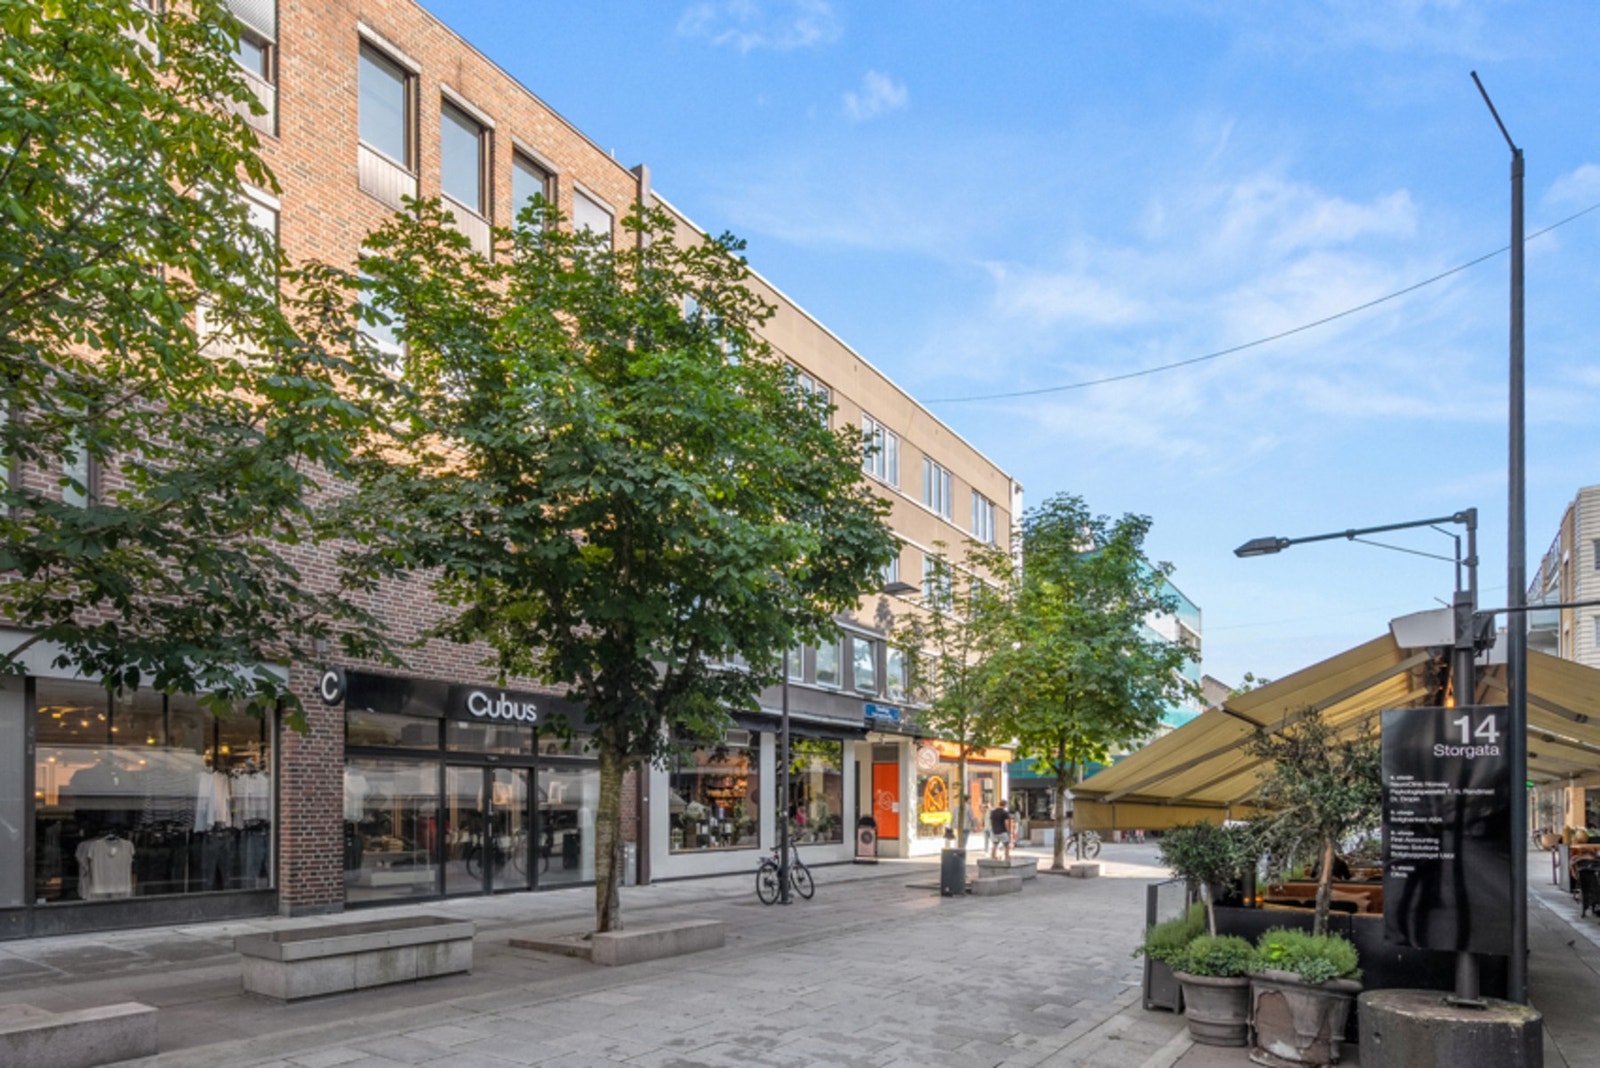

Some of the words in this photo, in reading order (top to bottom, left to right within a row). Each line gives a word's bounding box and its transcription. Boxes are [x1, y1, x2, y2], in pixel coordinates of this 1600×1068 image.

[321, 671, 338, 700] C
[467, 691, 537, 722] Cubus
[1453, 714, 1500, 744] 14
[1433, 743, 1500, 759] Storgata
